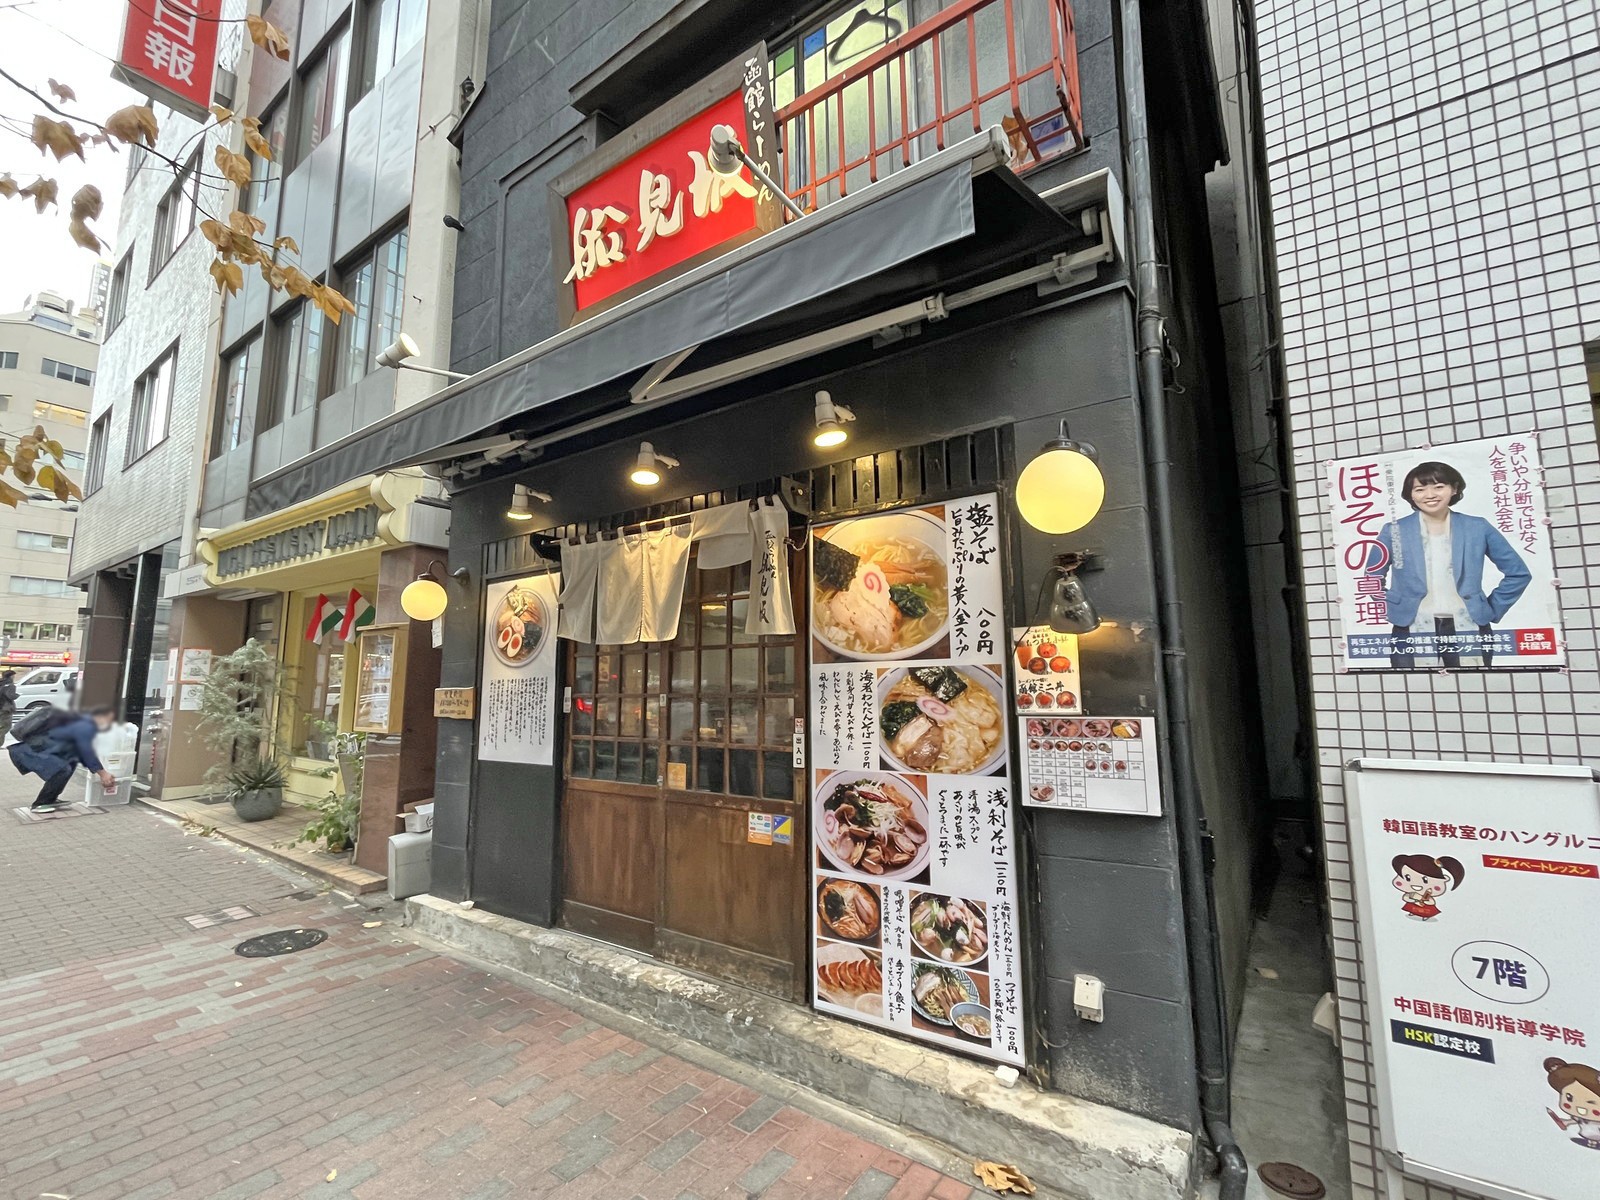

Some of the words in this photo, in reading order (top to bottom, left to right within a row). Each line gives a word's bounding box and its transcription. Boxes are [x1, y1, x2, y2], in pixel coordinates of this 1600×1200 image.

[144, 0, 198, 86] 日報
[744, 57, 774, 206] 函館らーめん
[1488, 445, 1514, 533] 人を育む社会を
[1508, 442, 1538, 555] 争いや分断ではなく
[965, 502, 997, 565] 塩そば
[1338, 463, 1390, 626] ほその真理
[951, 508, 971, 657] 旨みたっぷりの黄金スープ
[1351, 633, 1512, 647] 再生エネルギーの推進で持続可能な社会を
[1352, 643, 1513, 656] 多様な「個人」の尊重、ジェンダー平等を
[1520, 641, 1552, 651] 共産党
[1524, 633, 1546, 642] 日本
[860, 670, 875, 739] 海老わんたんそば
[987, 787, 1009, 857] 浅利そば
[1489, 857, 1591, 875] プライベートレッスン
[1001, 901, 1013, 953] 海鮮たんめん
[894, 959, 906, 1014] 手づくり餃子
[1005, 982, 1018, 1015] つけそば
[1472, 956, 1528, 990] 7階
[1394, 996, 1587, 1048] 中国語個別指導学院
[1404, 1027, 1482, 1056] HSK認定校
